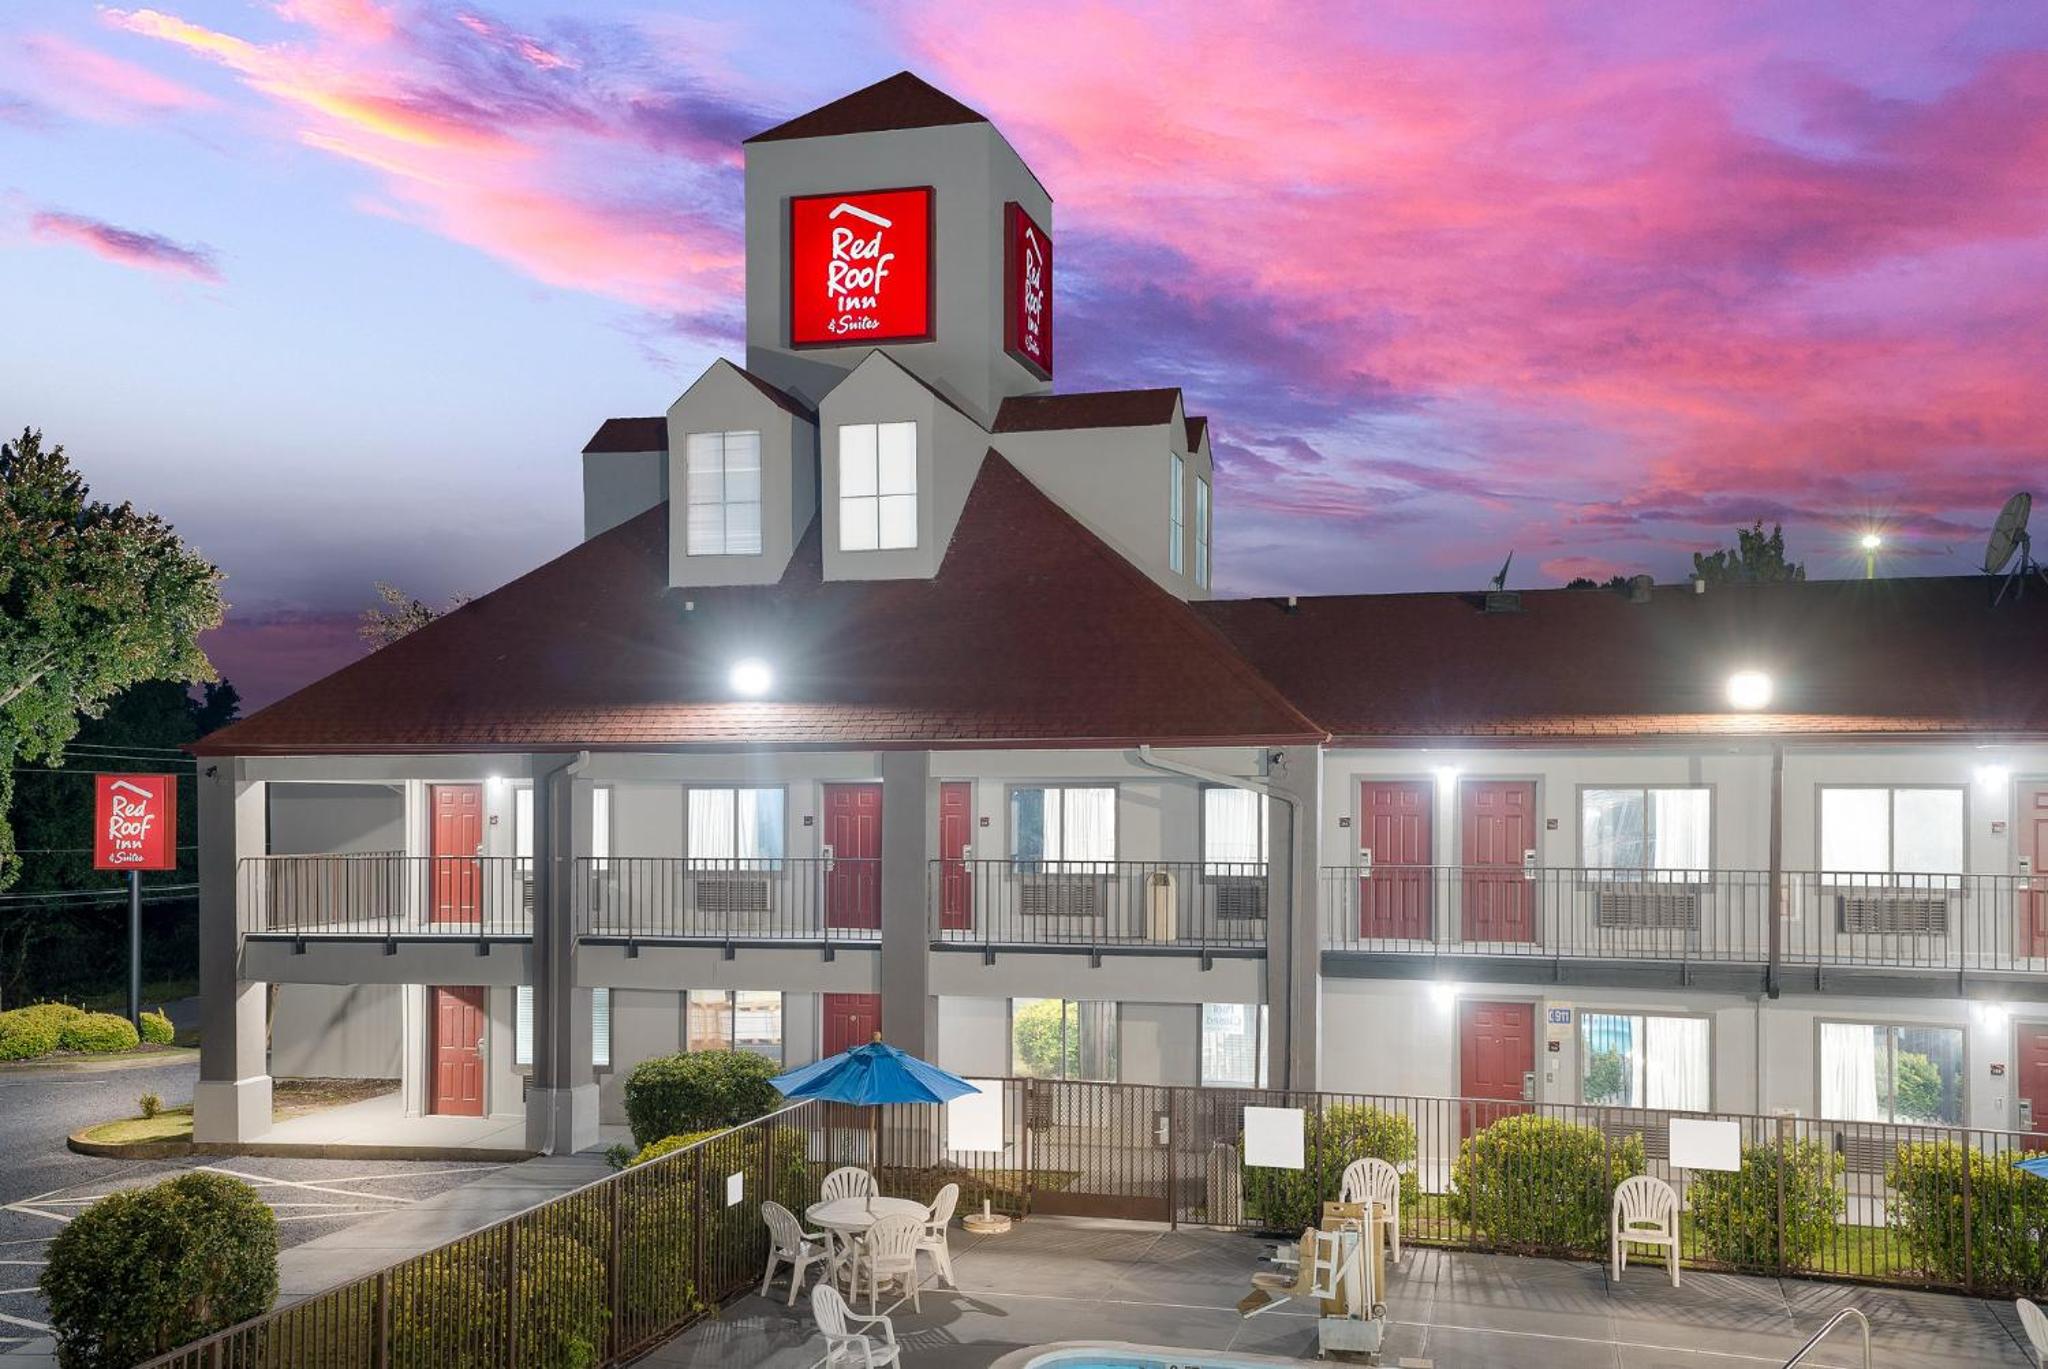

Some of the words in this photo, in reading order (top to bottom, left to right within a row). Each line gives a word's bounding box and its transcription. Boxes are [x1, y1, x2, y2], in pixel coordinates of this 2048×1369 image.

[832, 227, 882, 261] Red
[827, 253, 895, 298] Roof
[1026, 248, 1041, 289] Red
[1025, 279, 1044, 326] Roof
[836, 315, 880, 334] Suites
[113, 795, 147, 818] Red
[109, 814, 155, 840] Roof
[114, 851, 144, 864] Suites
